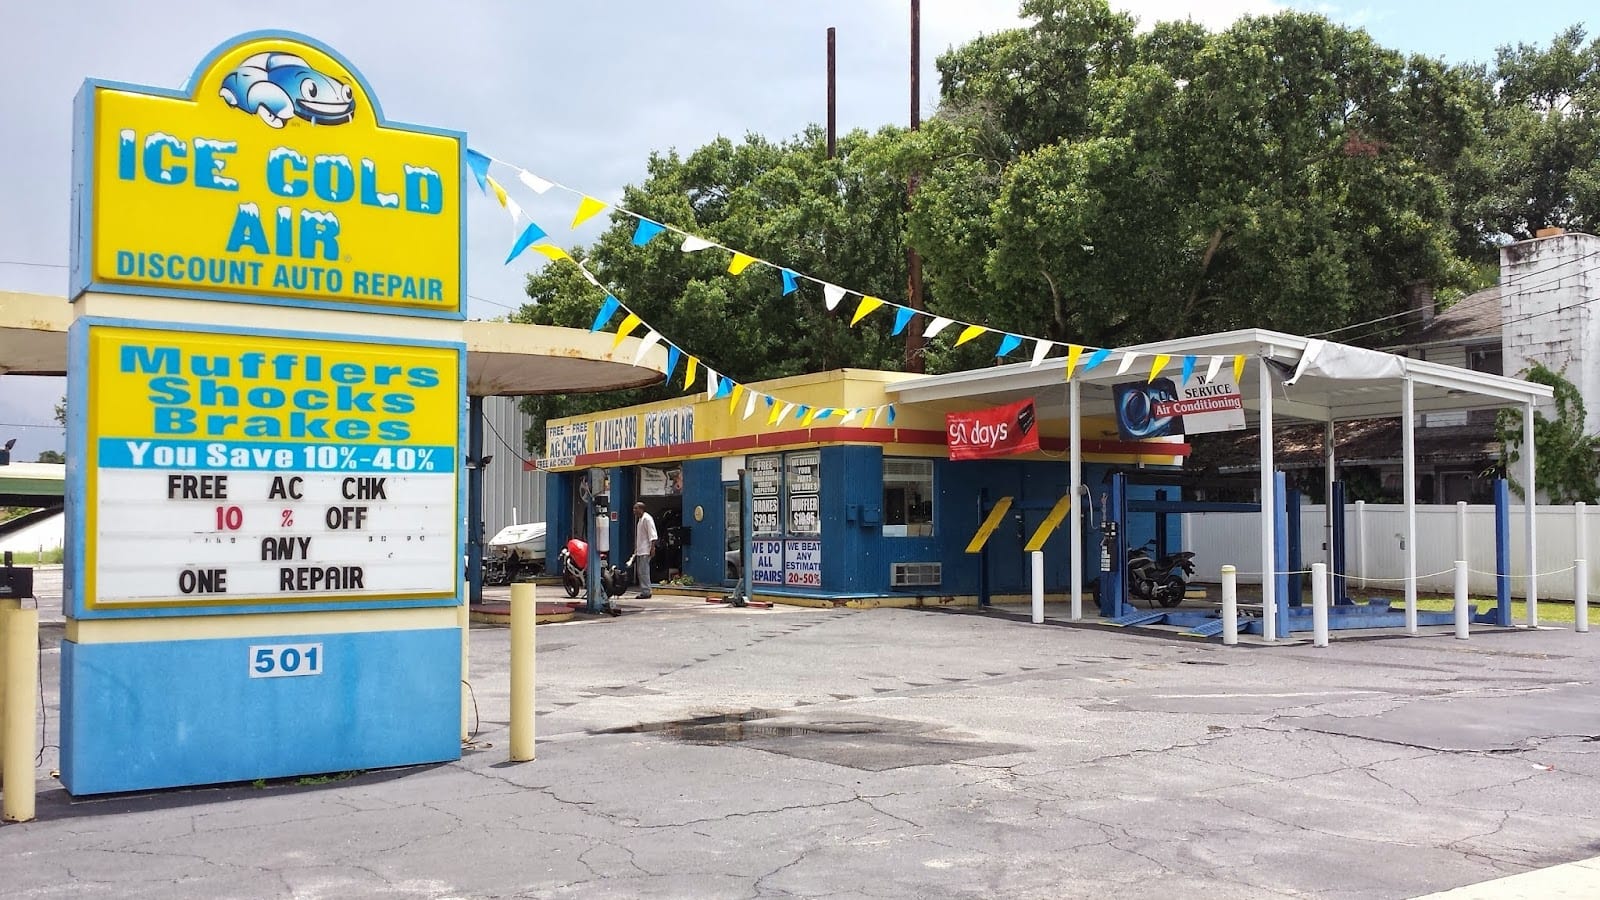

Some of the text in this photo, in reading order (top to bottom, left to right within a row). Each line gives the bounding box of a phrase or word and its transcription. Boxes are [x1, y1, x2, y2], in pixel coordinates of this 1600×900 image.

[119, 129, 443, 215] ICE COLD
[226, 202, 340, 261] AIR
[116, 250, 443, 301] DISCOUNT AUTO REPAIR
[120, 345, 440, 387] Mufflers
[148, 376, 415, 414] Shocks
[1184, 384, 1232, 399] SERVICE
[1156, 397, 1241, 416] Air Conditioning
[154, 406, 411, 441] Brakes
[549, 426, 565, 438] FREE
[572, 421, 588, 433] FREE
[970, 420, 1008, 448] days
[126, 441, 434, 471] You Save 10%-40%
[562, 434, 588, 457] CHECK
[168, 475, 387, 500] FREE AC CHK
[754, 500, 777, 513] BRAKES
[791, 498, 818, 512] MUFFLER
[215, 506, 367, 531] 10 % OFF
[261, 536, 312, 561] ANY
[752, 542, 780, 554] WE DO
[787, 543, 820, 551] WE BEAT
[758, 556, 773, 568] ALL
[179, 566, 365, 594] ONE REPAIR
[788, 573, 820, 584] 20-50%
[255, 648, 318, 673] 501
